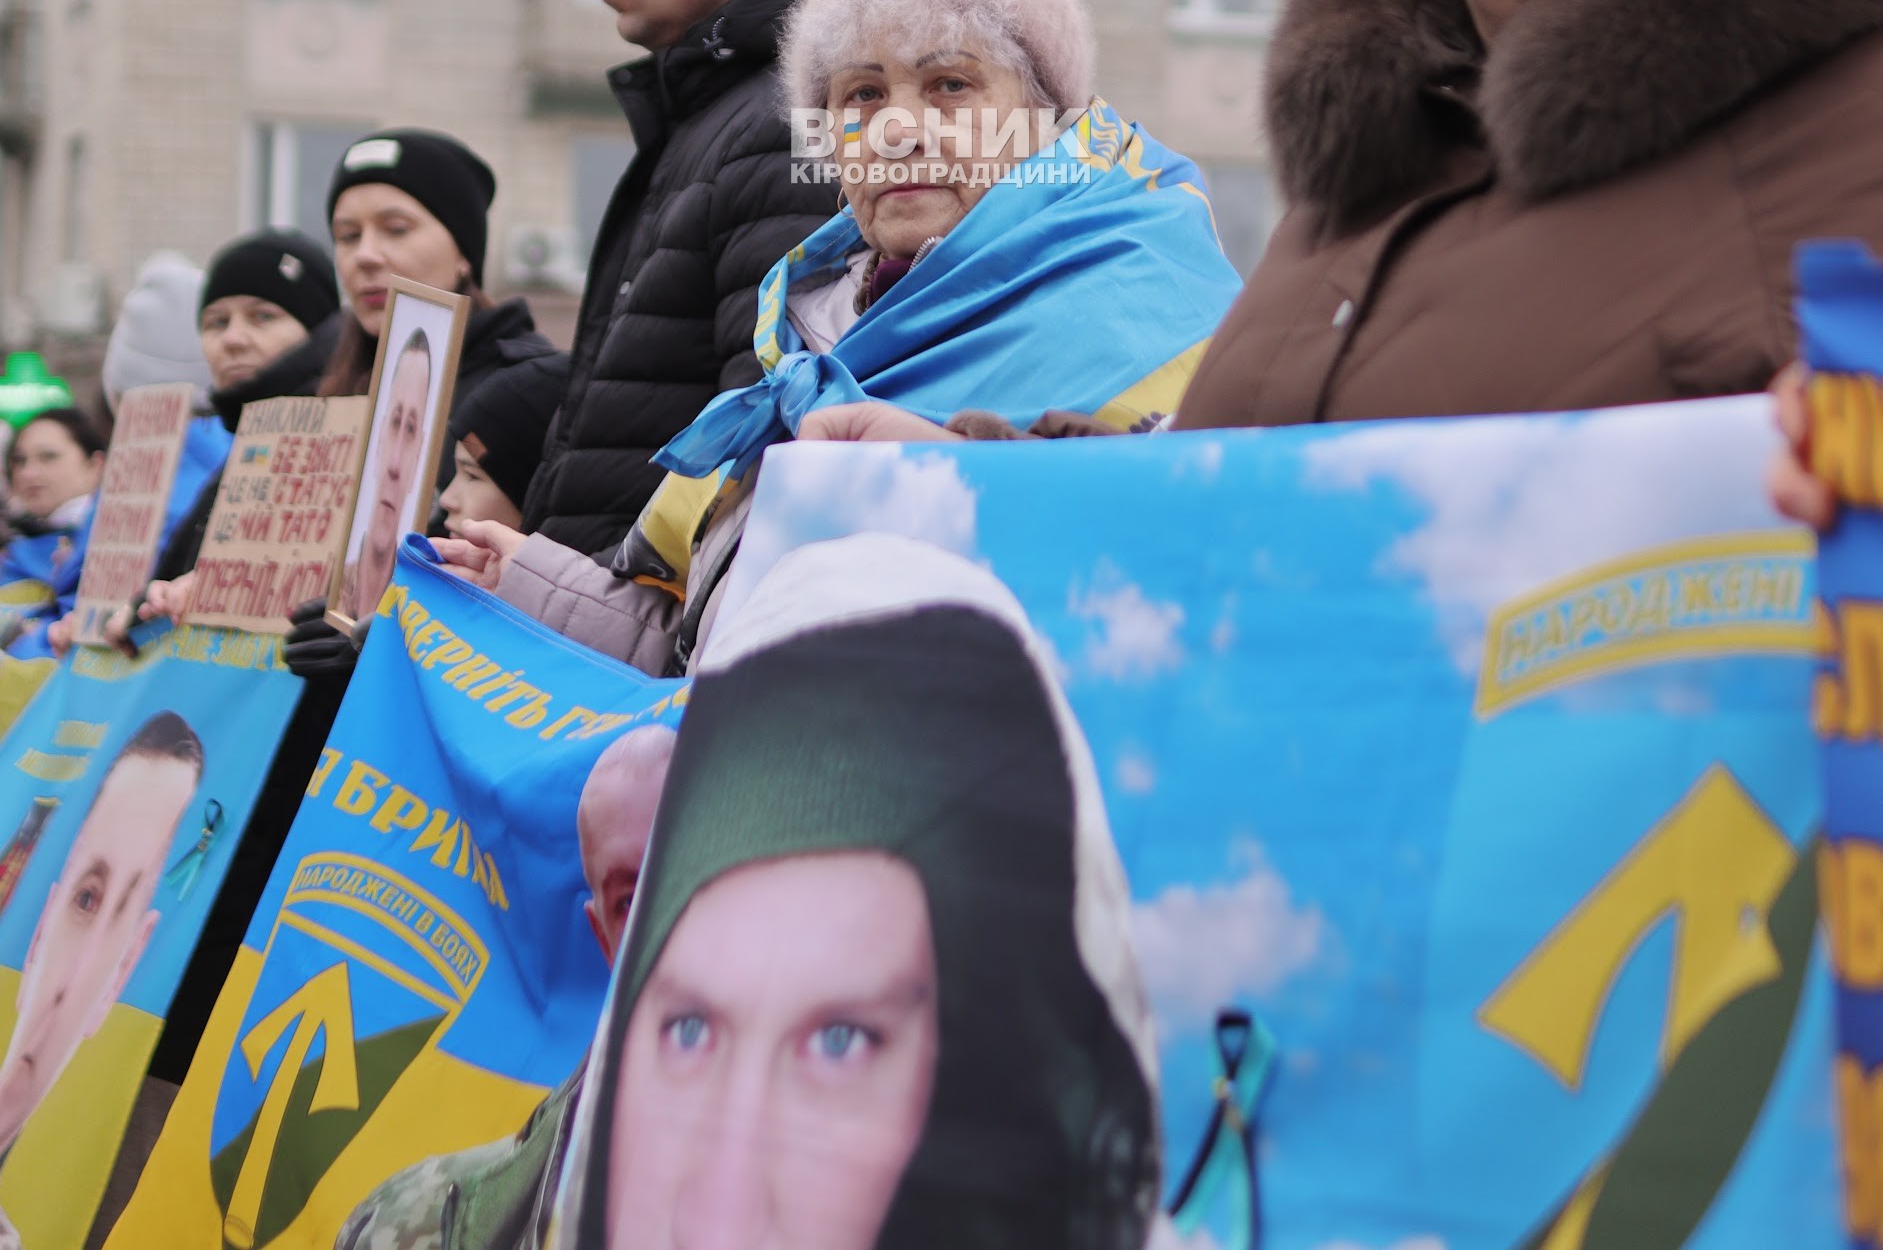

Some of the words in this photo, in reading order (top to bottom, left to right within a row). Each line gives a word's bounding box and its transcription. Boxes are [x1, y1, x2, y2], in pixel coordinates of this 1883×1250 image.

[297, 865, 418, 923] НАРОДЖЕНІ
[413, 913, 436, 935] В
[430, 927, 478, 983] БОЯХ
